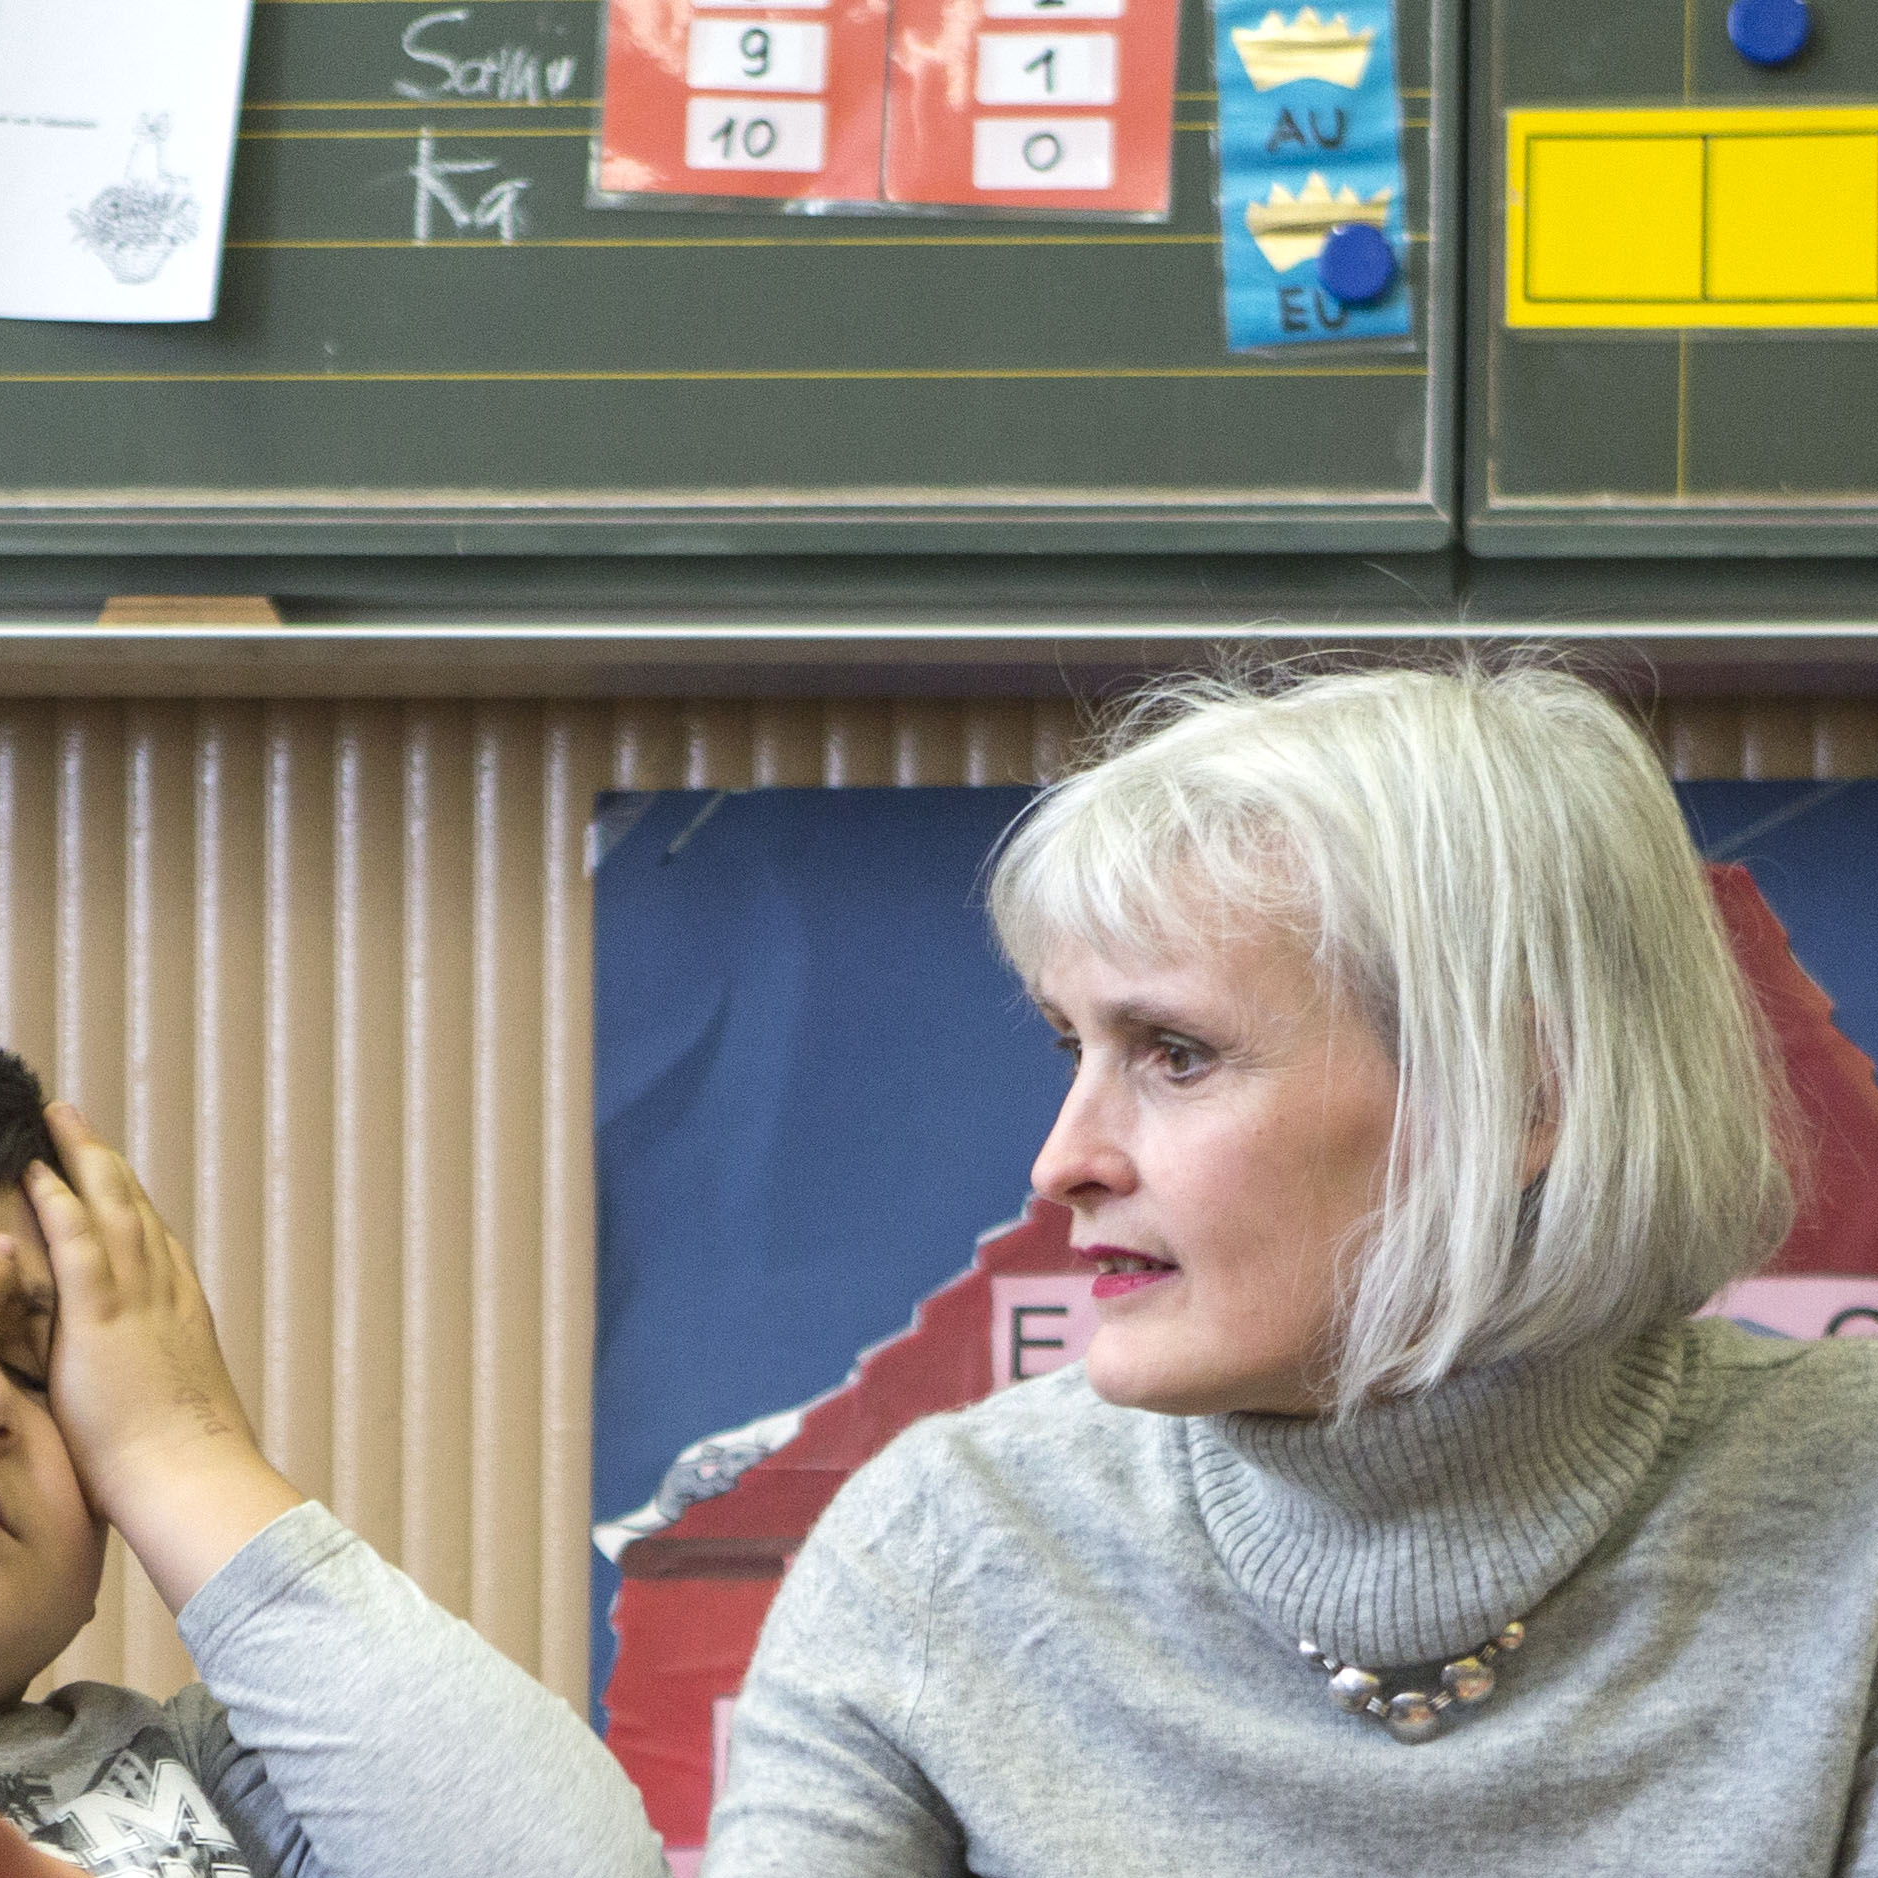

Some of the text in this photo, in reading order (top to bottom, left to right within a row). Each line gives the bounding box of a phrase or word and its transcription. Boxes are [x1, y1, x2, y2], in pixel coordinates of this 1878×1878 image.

[740, 28, 770, 78] 9
[1023, 47, 1056, 94] 1
[710, 118, 778, 160] 10
[1022, 132, 1061, 172] 0
[1266, 106, 1347, 152] AU
